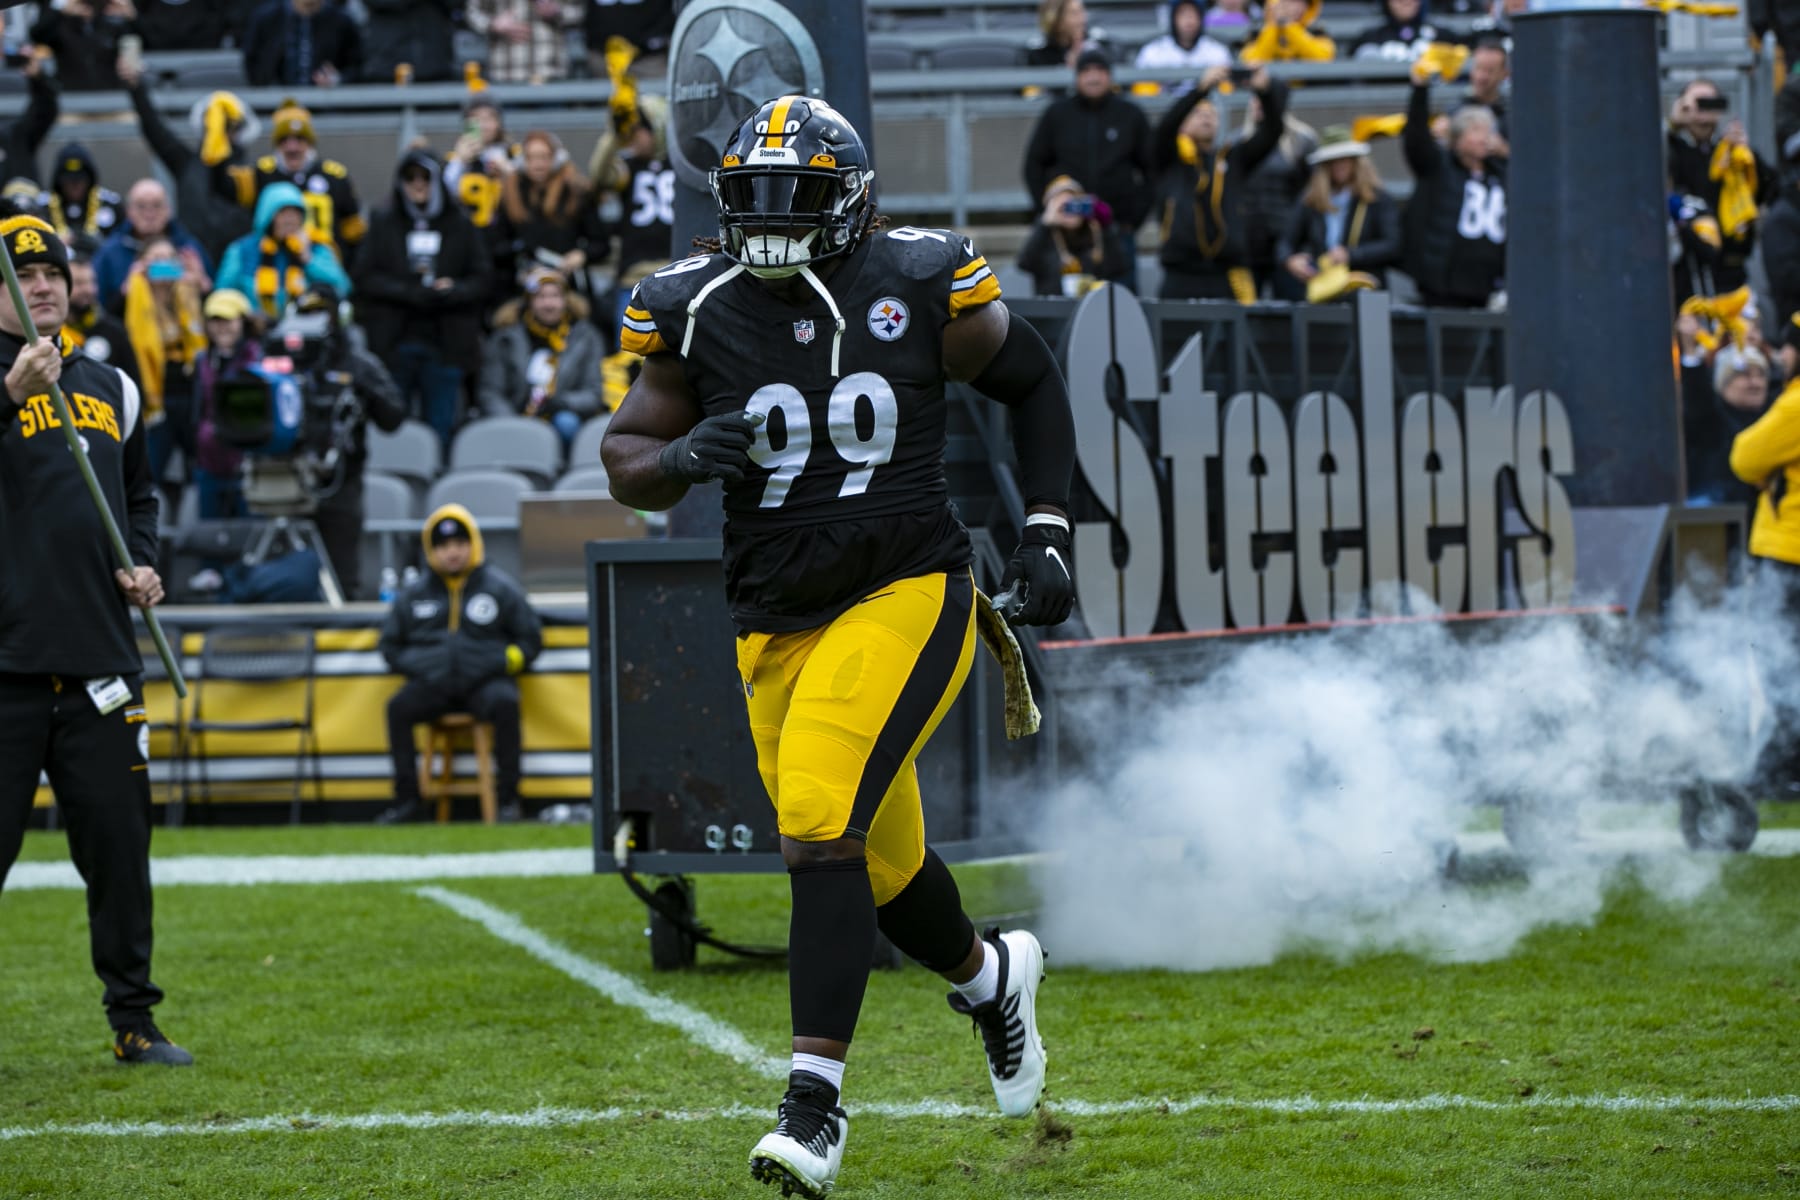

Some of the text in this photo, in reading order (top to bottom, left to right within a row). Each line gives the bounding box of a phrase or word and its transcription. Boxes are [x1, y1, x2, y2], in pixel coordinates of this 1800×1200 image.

[759, 149, 786, 157] Steelers
[19, 389, 121, 442] STELERS
[744, 371, 898, 508] 99
[1067, 281, 1576, 640] Steelers
